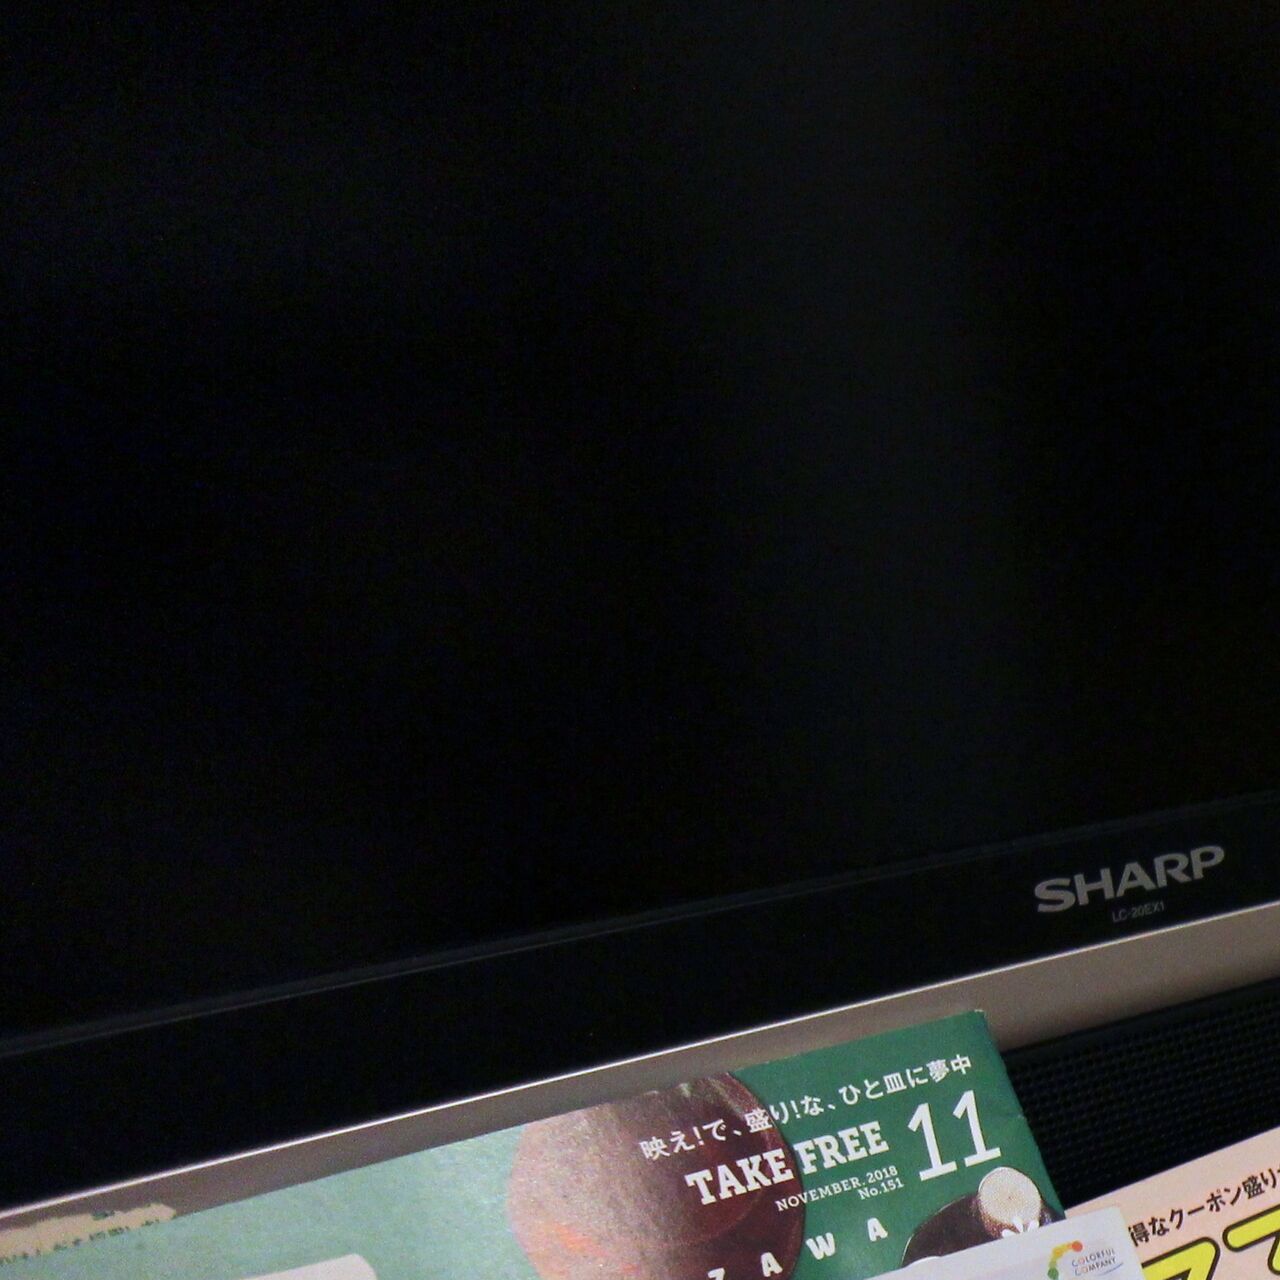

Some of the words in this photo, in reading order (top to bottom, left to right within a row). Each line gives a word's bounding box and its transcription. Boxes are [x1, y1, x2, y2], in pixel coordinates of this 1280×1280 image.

[1034, 846, 1225, 913] SHARP
[685, 1148, 794, 1206] TAKE
[792, 1120, 890, 1175] FREE
[907, 1089, 1001, 1182] 11
[858, 1178, 905, 1201] No.151
